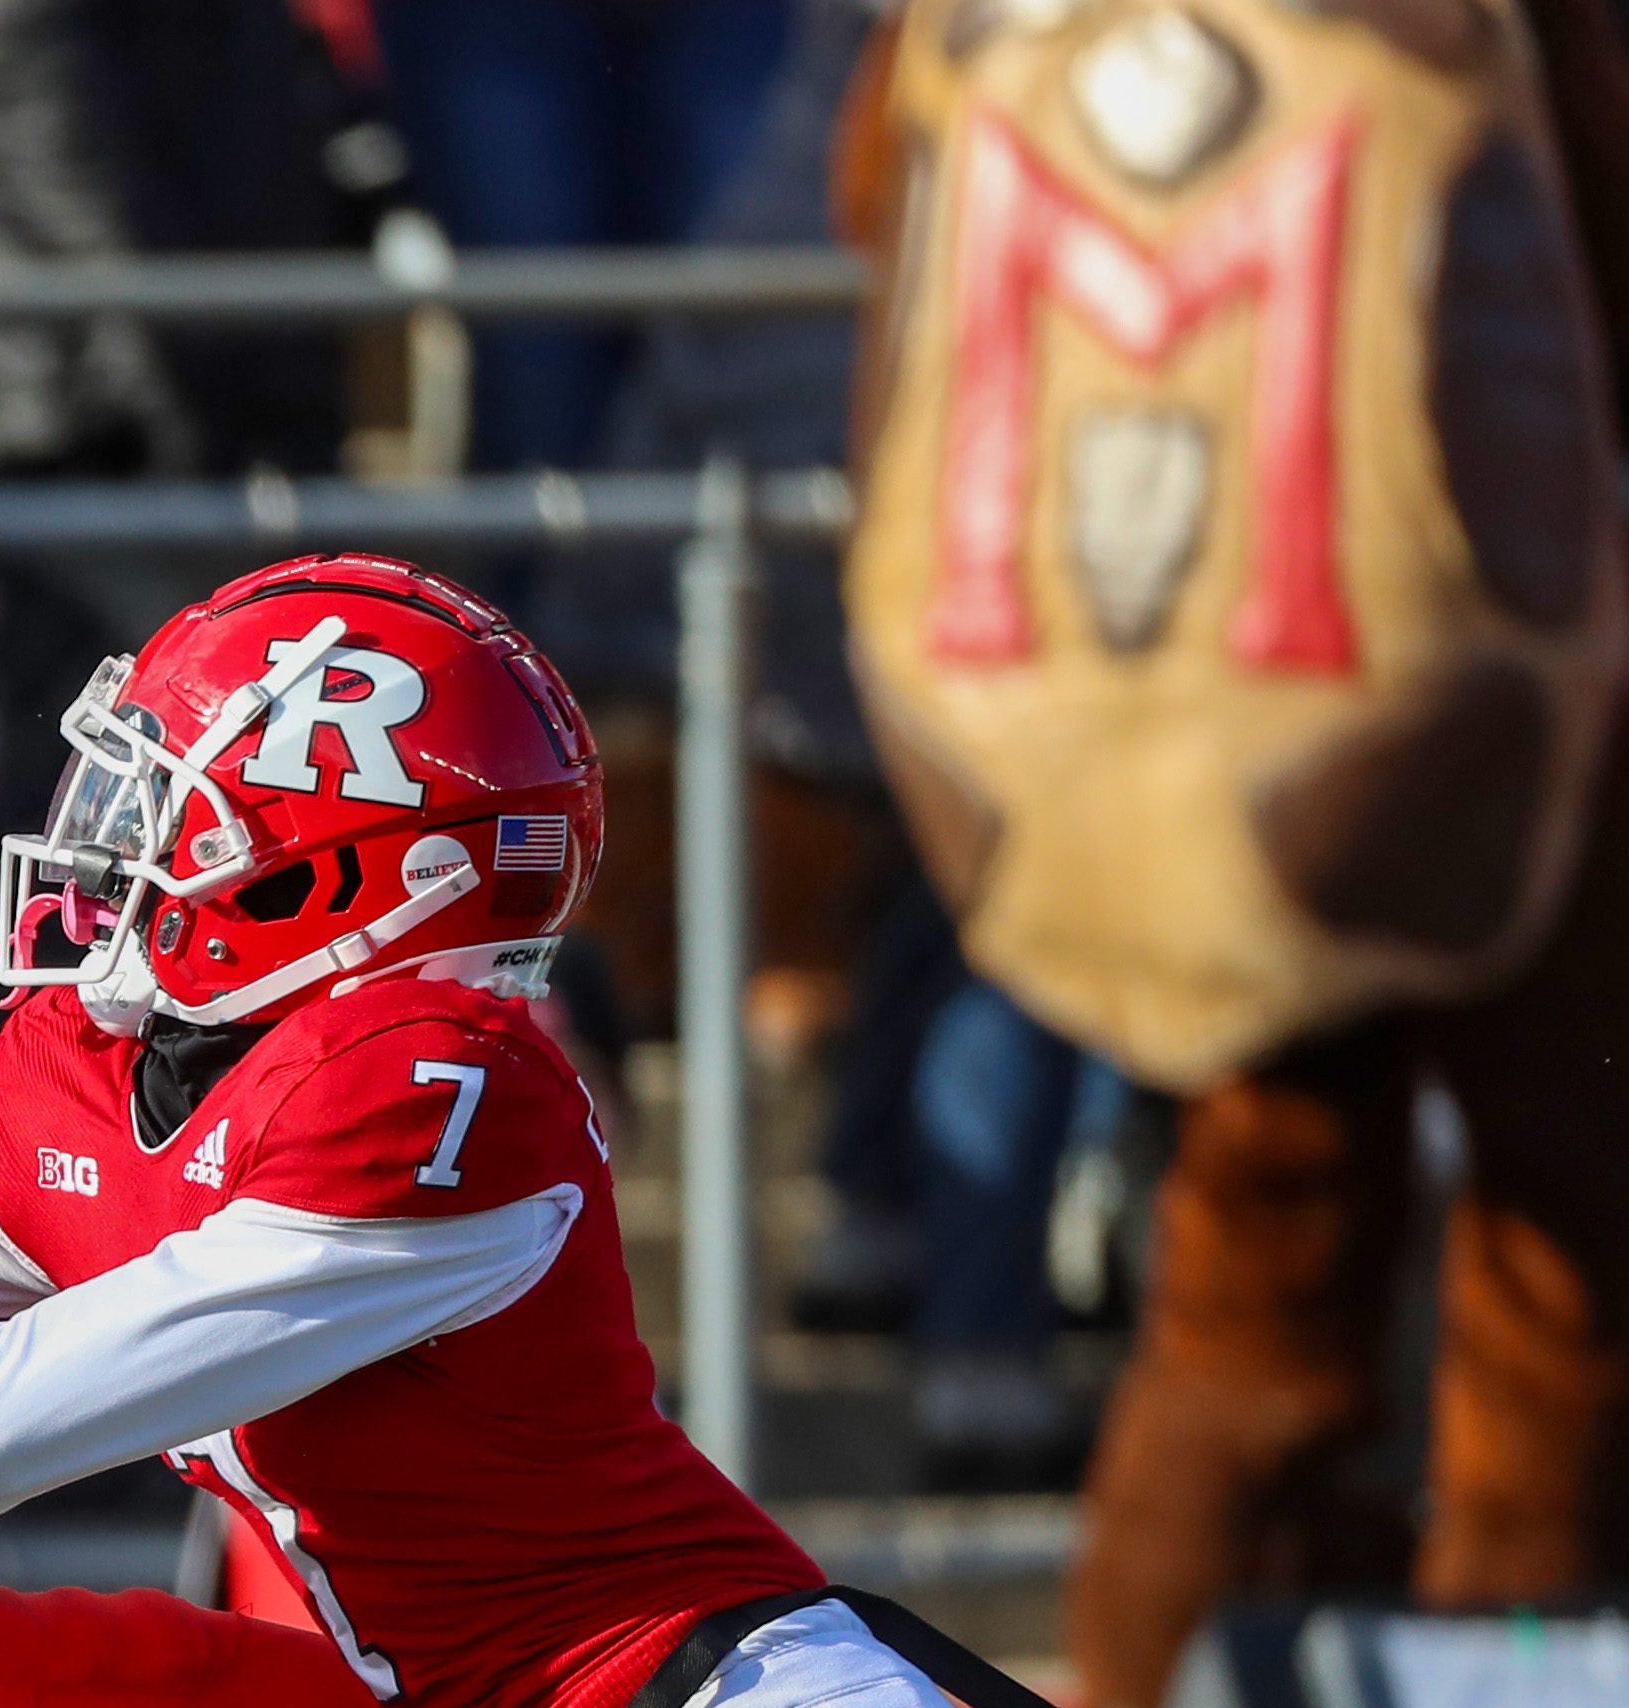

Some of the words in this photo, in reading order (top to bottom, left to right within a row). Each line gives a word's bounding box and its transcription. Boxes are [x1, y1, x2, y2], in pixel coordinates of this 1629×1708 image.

[922, 104, 1366, 674] M
[242, 638, 426, 808] R
[182, 1160, 226, 1190] adidas
[411, 1058, 488, 1188] 7
